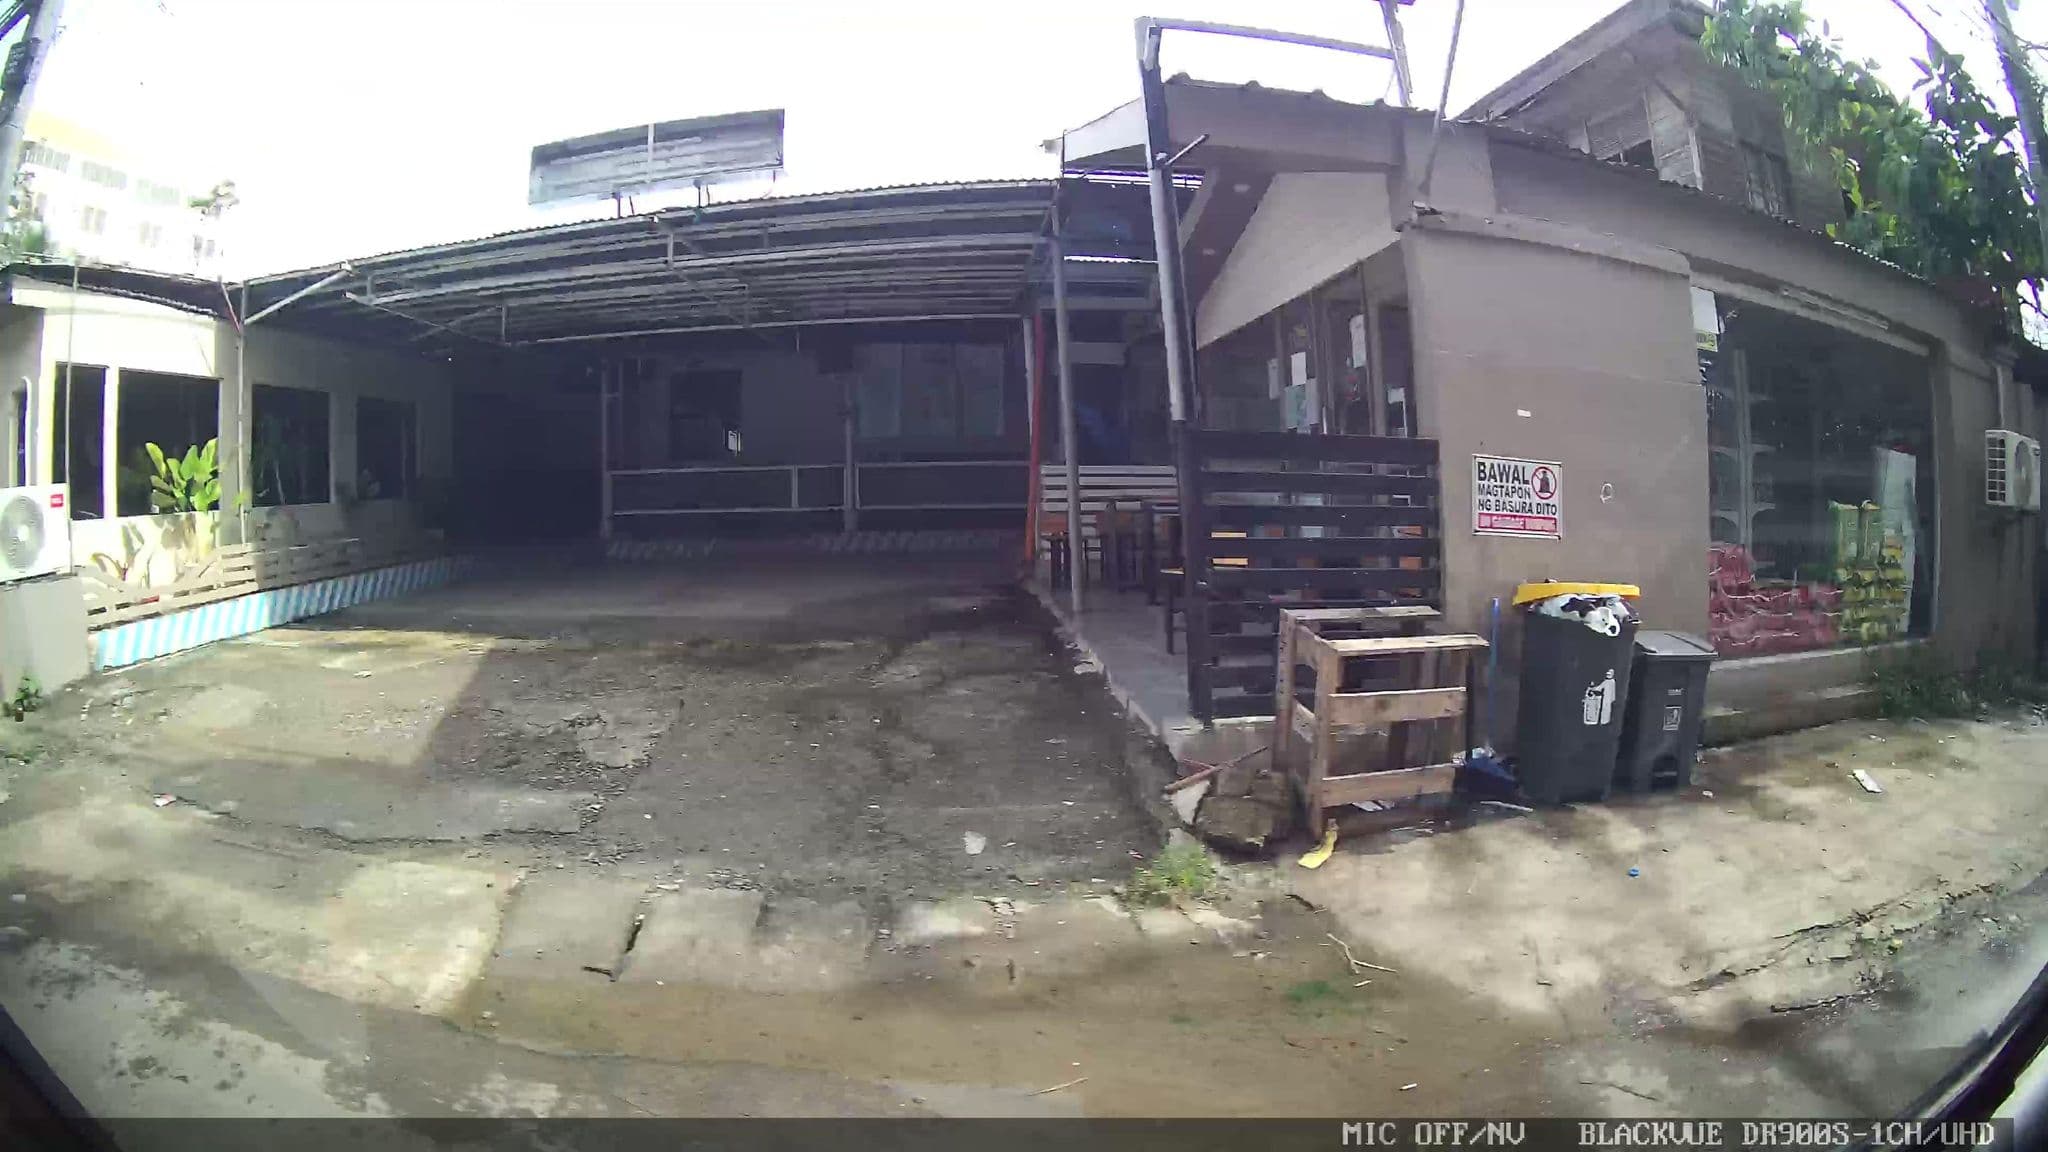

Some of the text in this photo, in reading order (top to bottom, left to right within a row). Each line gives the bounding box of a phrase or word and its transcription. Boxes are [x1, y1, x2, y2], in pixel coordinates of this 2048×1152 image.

[1478, 462, 1530, 485] BAWAL
[1478, 484, 1531, 499] MAGTAPON
[1478, 499, 1557, 515] NG BASURA DITO
